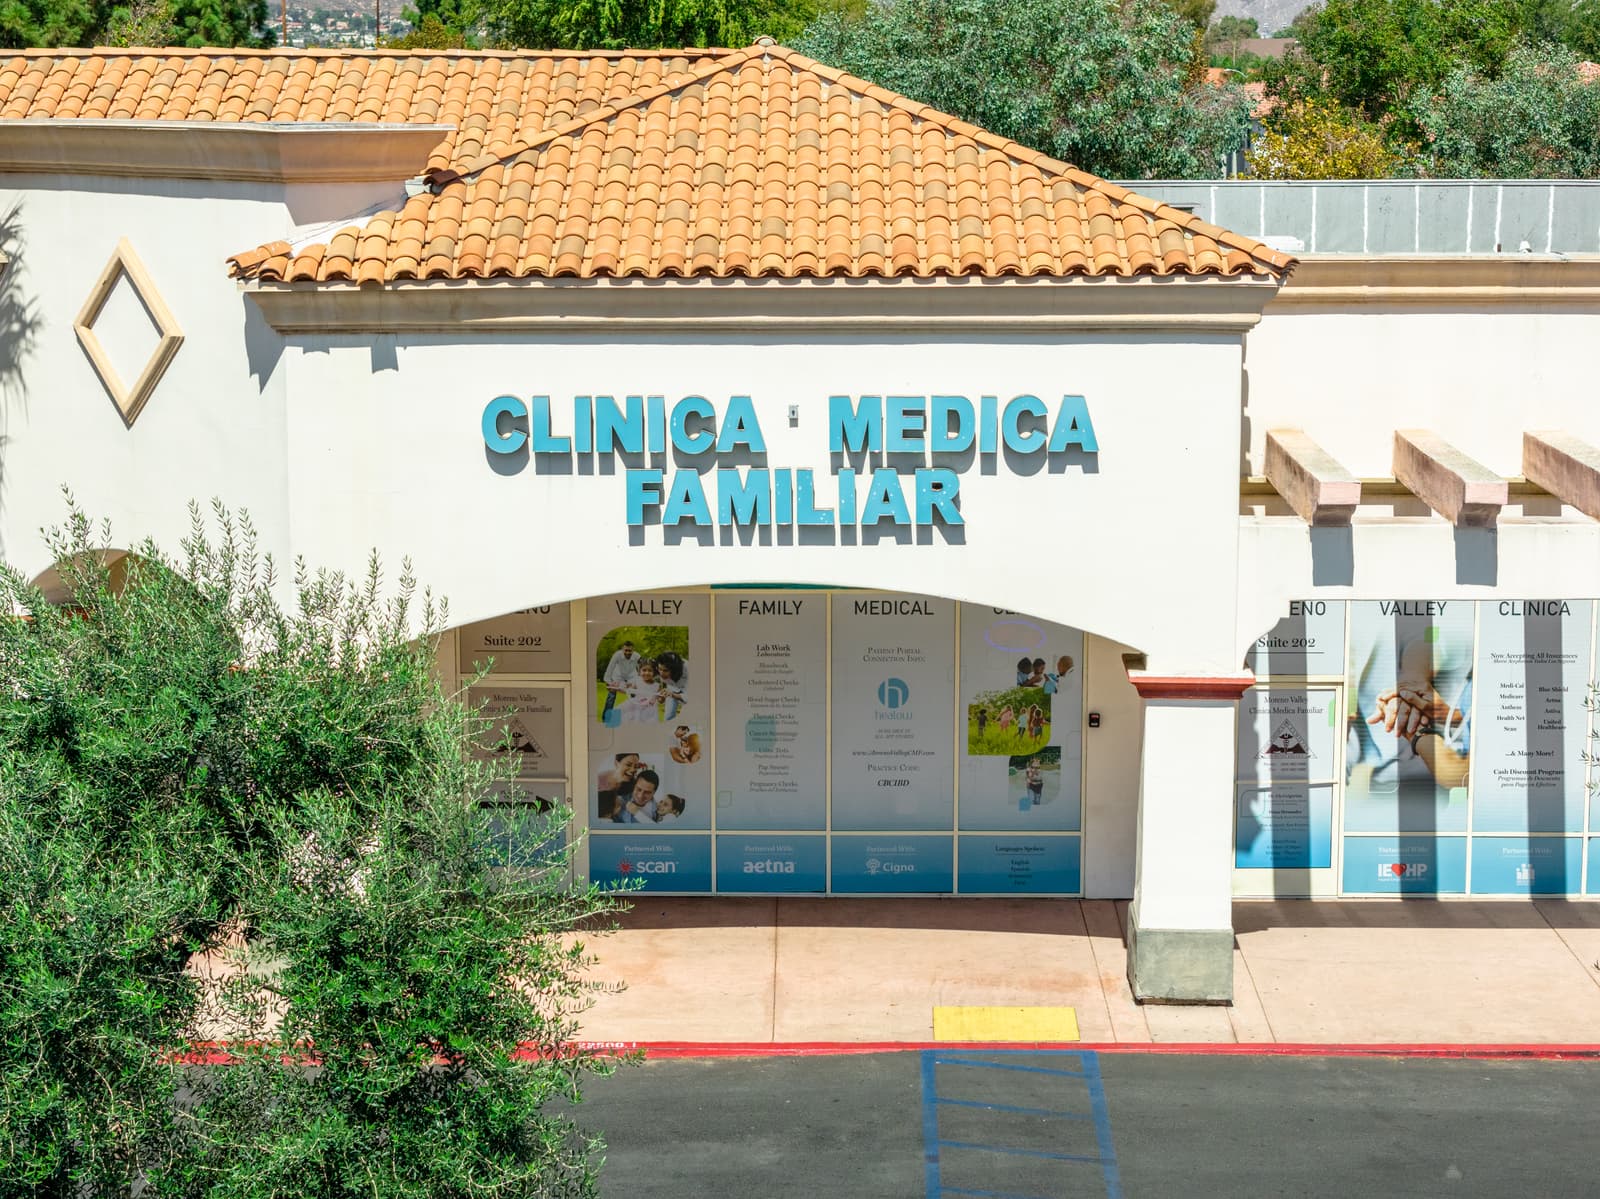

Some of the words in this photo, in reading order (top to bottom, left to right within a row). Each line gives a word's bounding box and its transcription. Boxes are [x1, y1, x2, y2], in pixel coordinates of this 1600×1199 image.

[481, 394, 768, 455] CLINICA
[829, 394, 1100, 454] MEDICA
[626, 467, 966, 526] FAMILIAR
[615, 600, 683, 615] VALLEY
[739, 600, 803, 615] FAMILY
[854, 600, 935, 615] MEDICAL
[1379, 601, 1447, 616] VALLEY
[1498, 601, 1571, 616] CLINICA
[484, 635, 515, 647] Suite
[518, 636, 542, 647] 202
[1257, 636, 1289, 648] Suite
[1291, 637, 1316, 648] 202
[636, 861, 676, 873] scan
[743, 859, 795, 873] aetna
